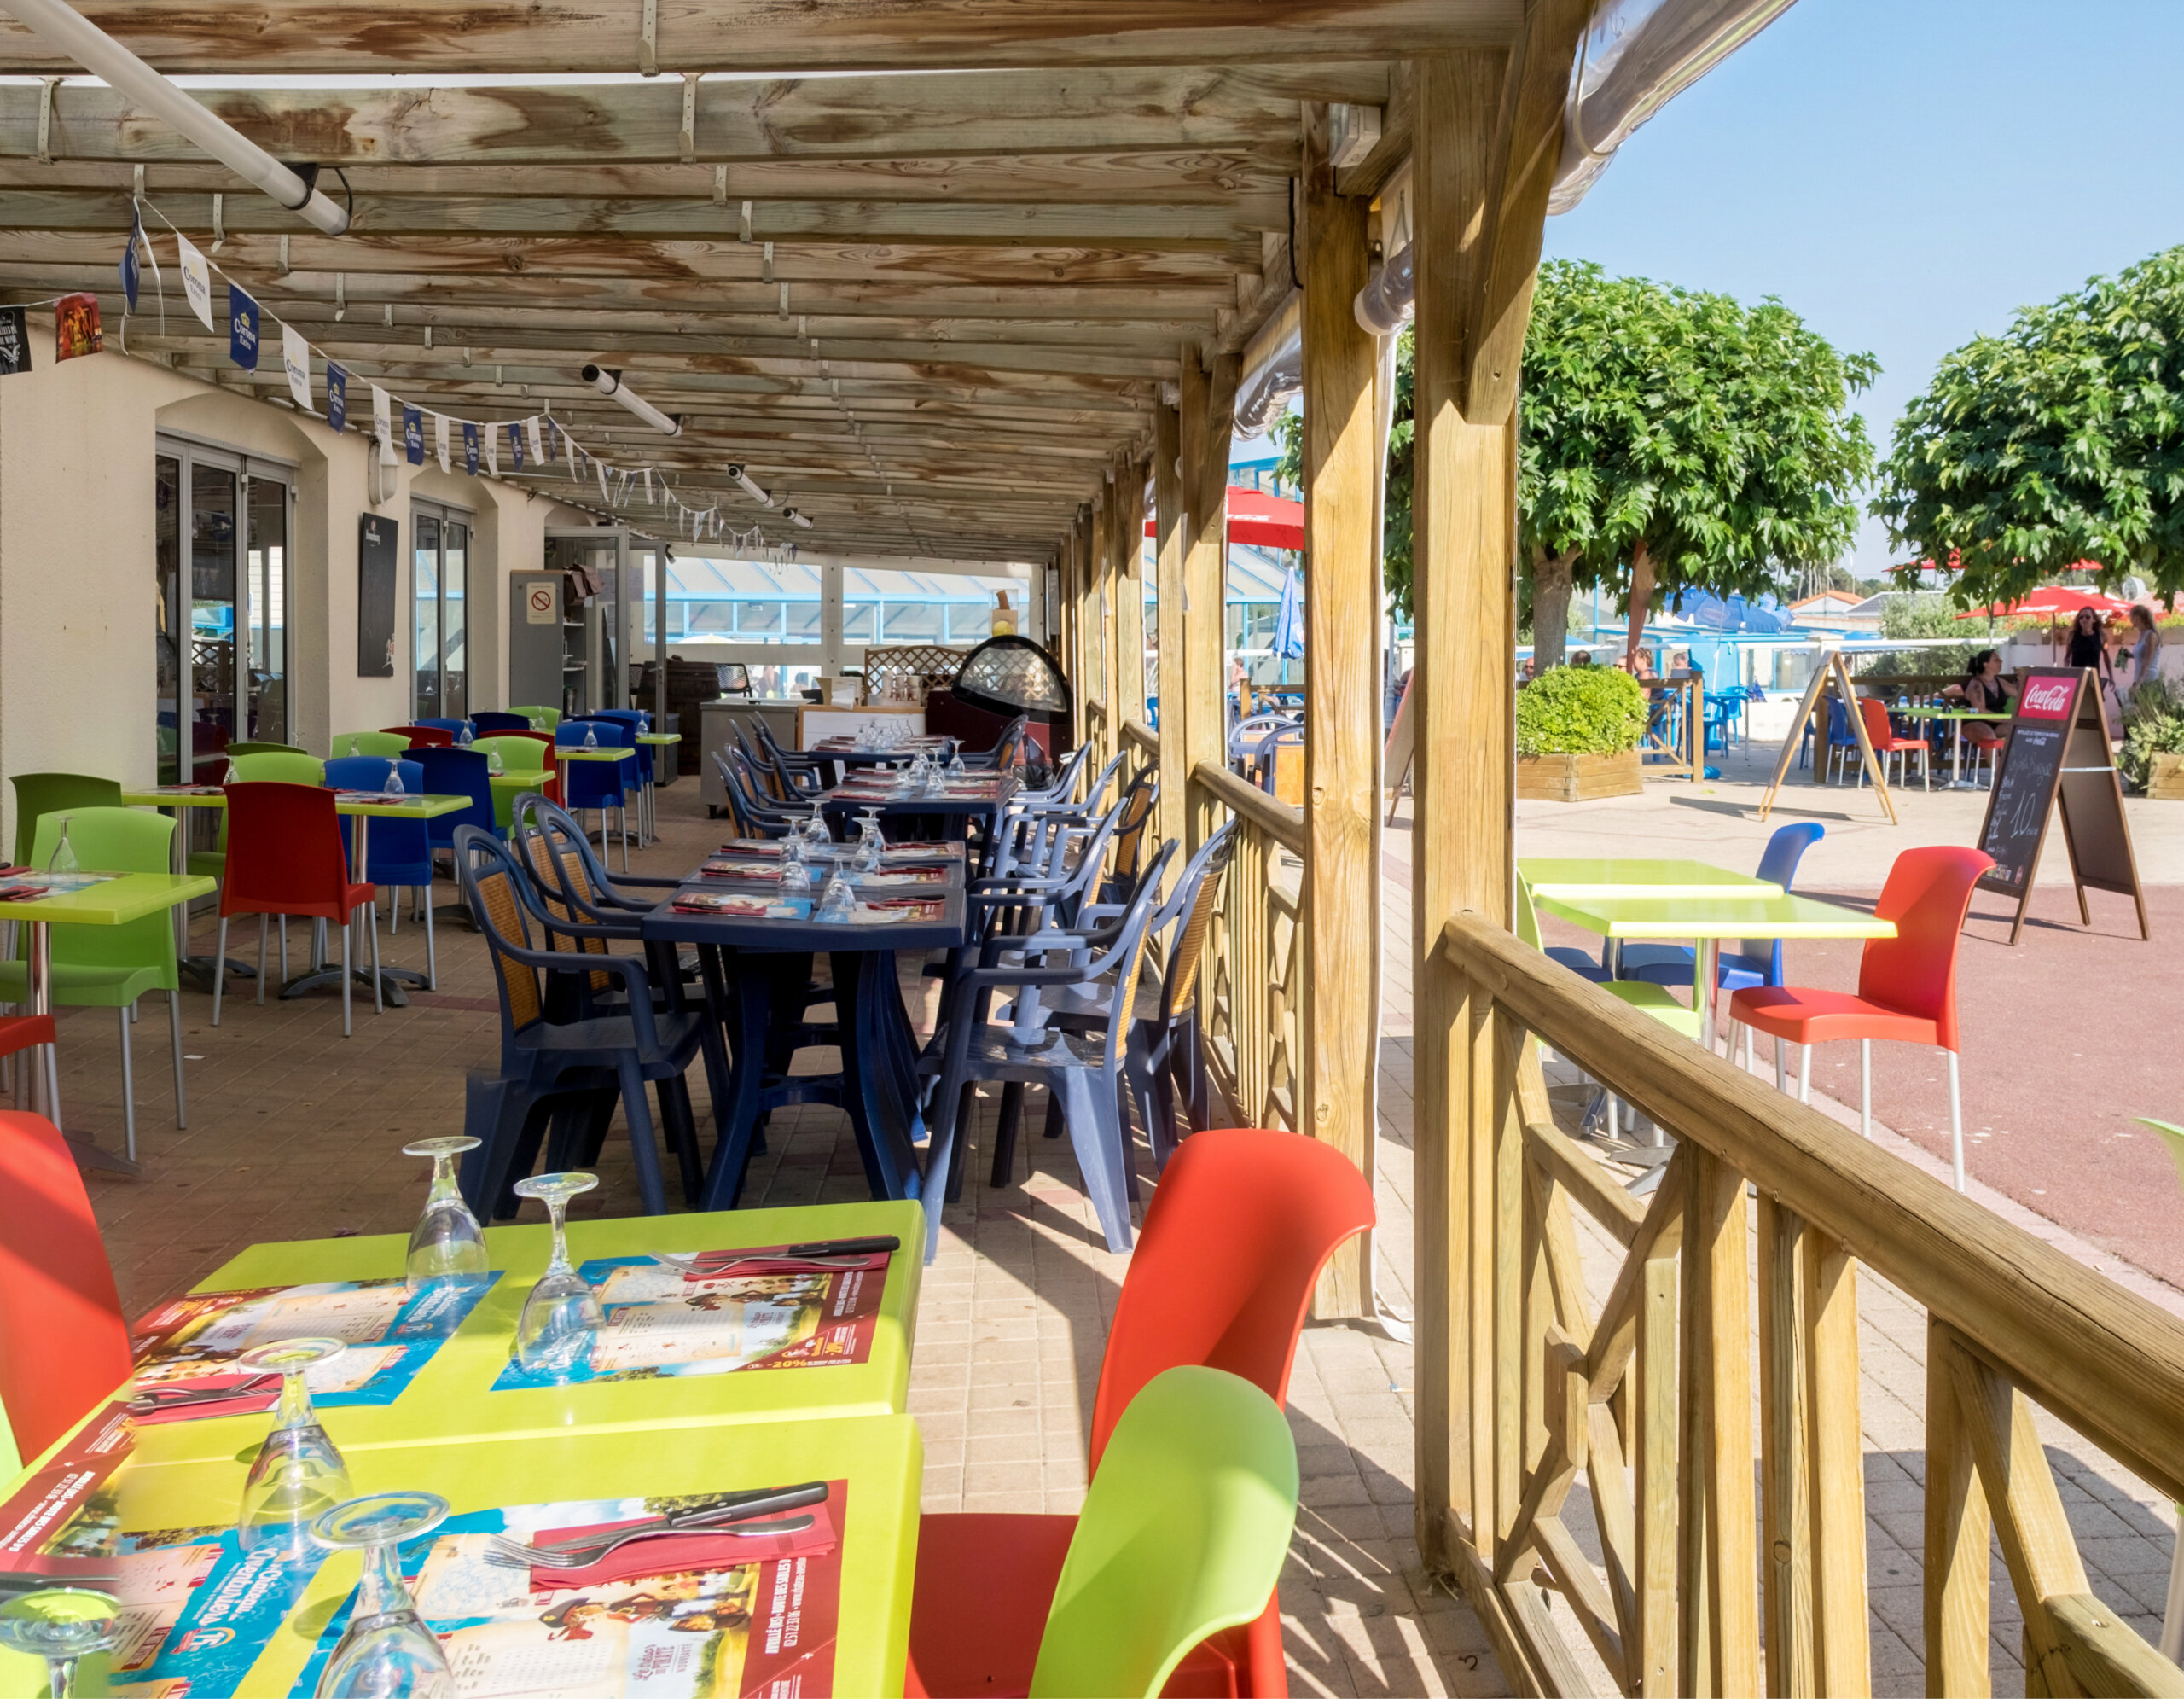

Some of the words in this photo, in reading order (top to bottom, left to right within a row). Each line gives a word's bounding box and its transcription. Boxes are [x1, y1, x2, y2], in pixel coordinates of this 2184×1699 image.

[183, 265, 206, 294] Corona
[234, 318, 256, 344] Corona
[240, 334, 252, 351] Extra
[286, 358, 305, 380] Corona
[329, 389, 344, 408] Corona
[406, 429, 421, 443] Corona
[2024, 684, 2070, 711] Coca-Cola
[2010, 790, 2036, 838] 10
[767, 1359, 807, 1368] -20%
[775, 1563, 791, 1583] SABLES
[774, 1583, 788, 1595] DES
[771, 1595, 787, 1614] ROUTE
[765, 1629, 781, 1654] AVRILLÉ
[653, 1645, 674, 1668] PIRATE
